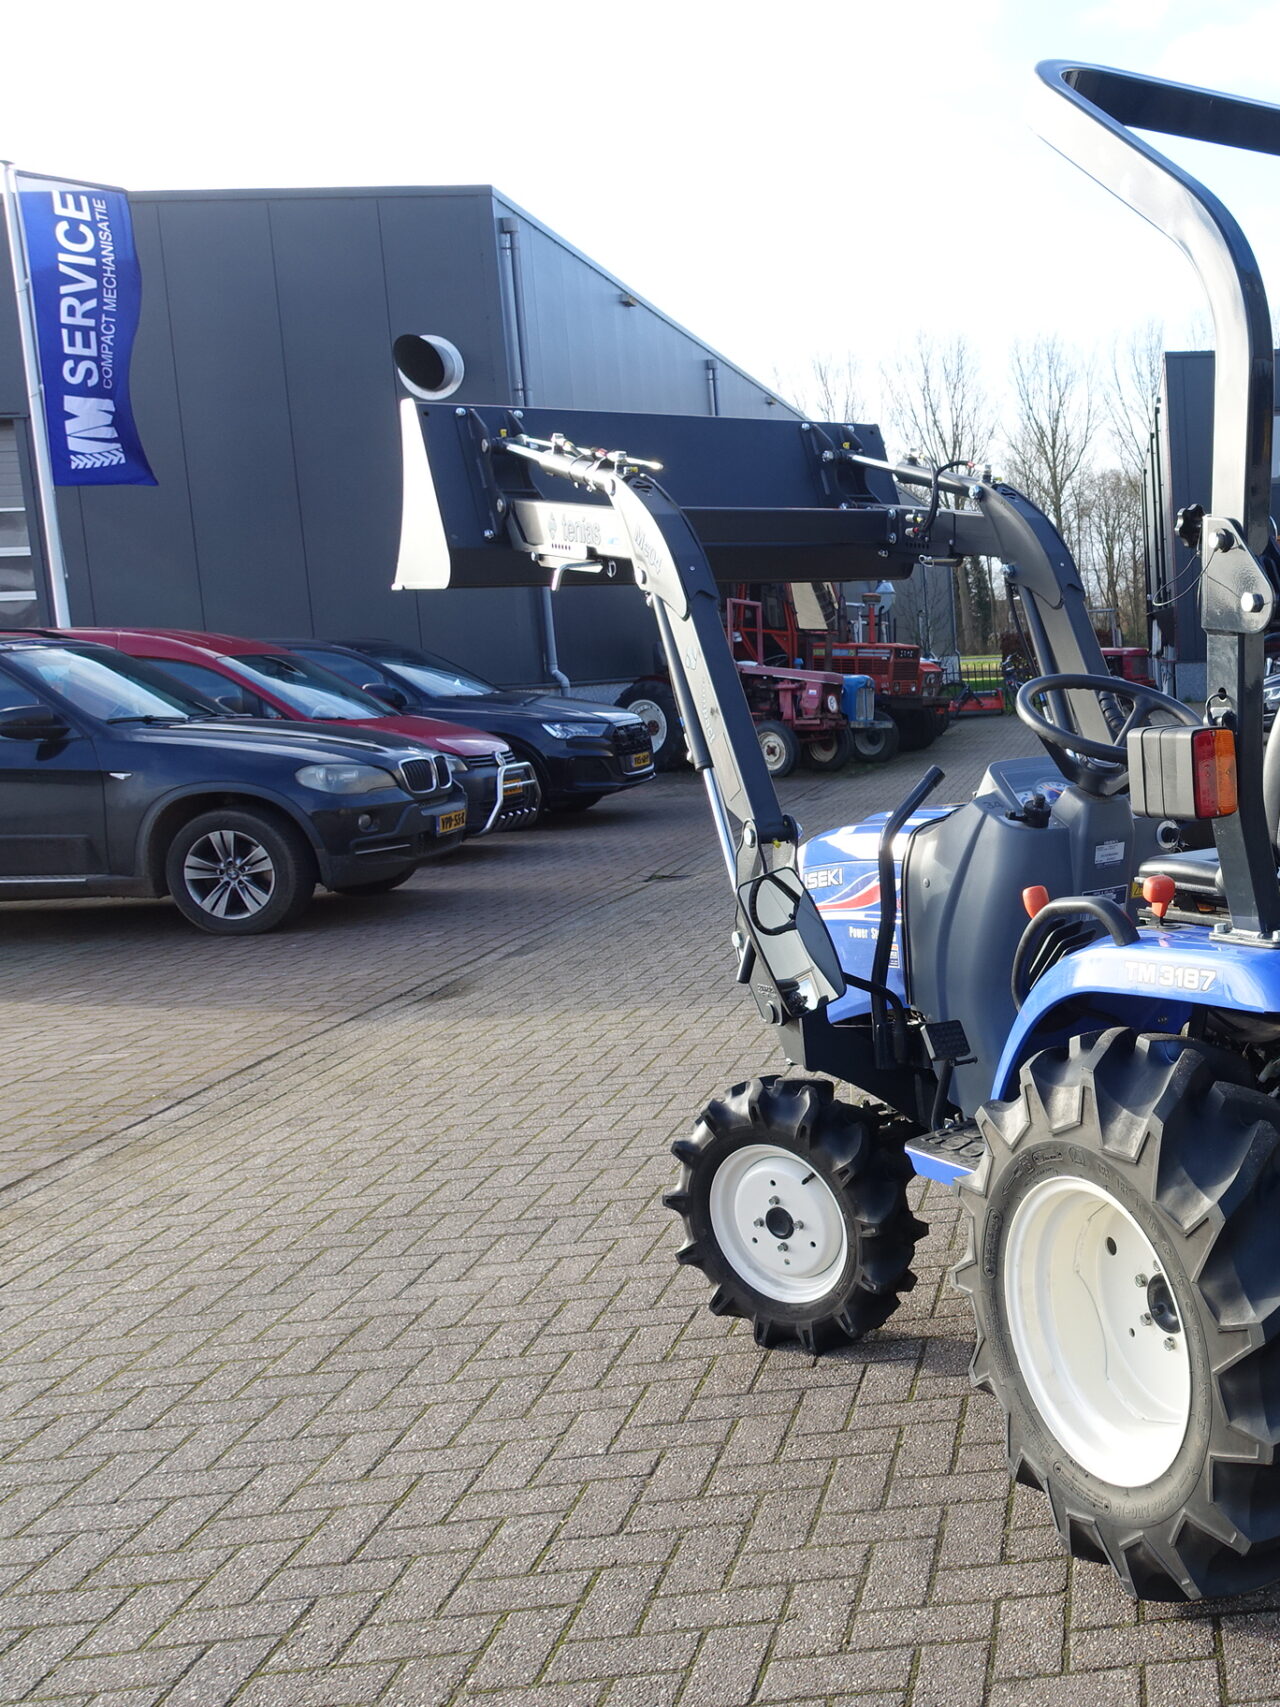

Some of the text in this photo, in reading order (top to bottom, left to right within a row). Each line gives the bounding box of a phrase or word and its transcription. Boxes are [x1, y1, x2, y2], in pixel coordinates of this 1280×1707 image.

[52, 190, 99, 387] SERVICE
[92, 197, 118, 390] COMPACT MECHANISATIE
[561, 514, 601, 547] tenias
[804, 867, 843, 890] ISEKI
[1124, 961, 1217, 991] TM 3187
